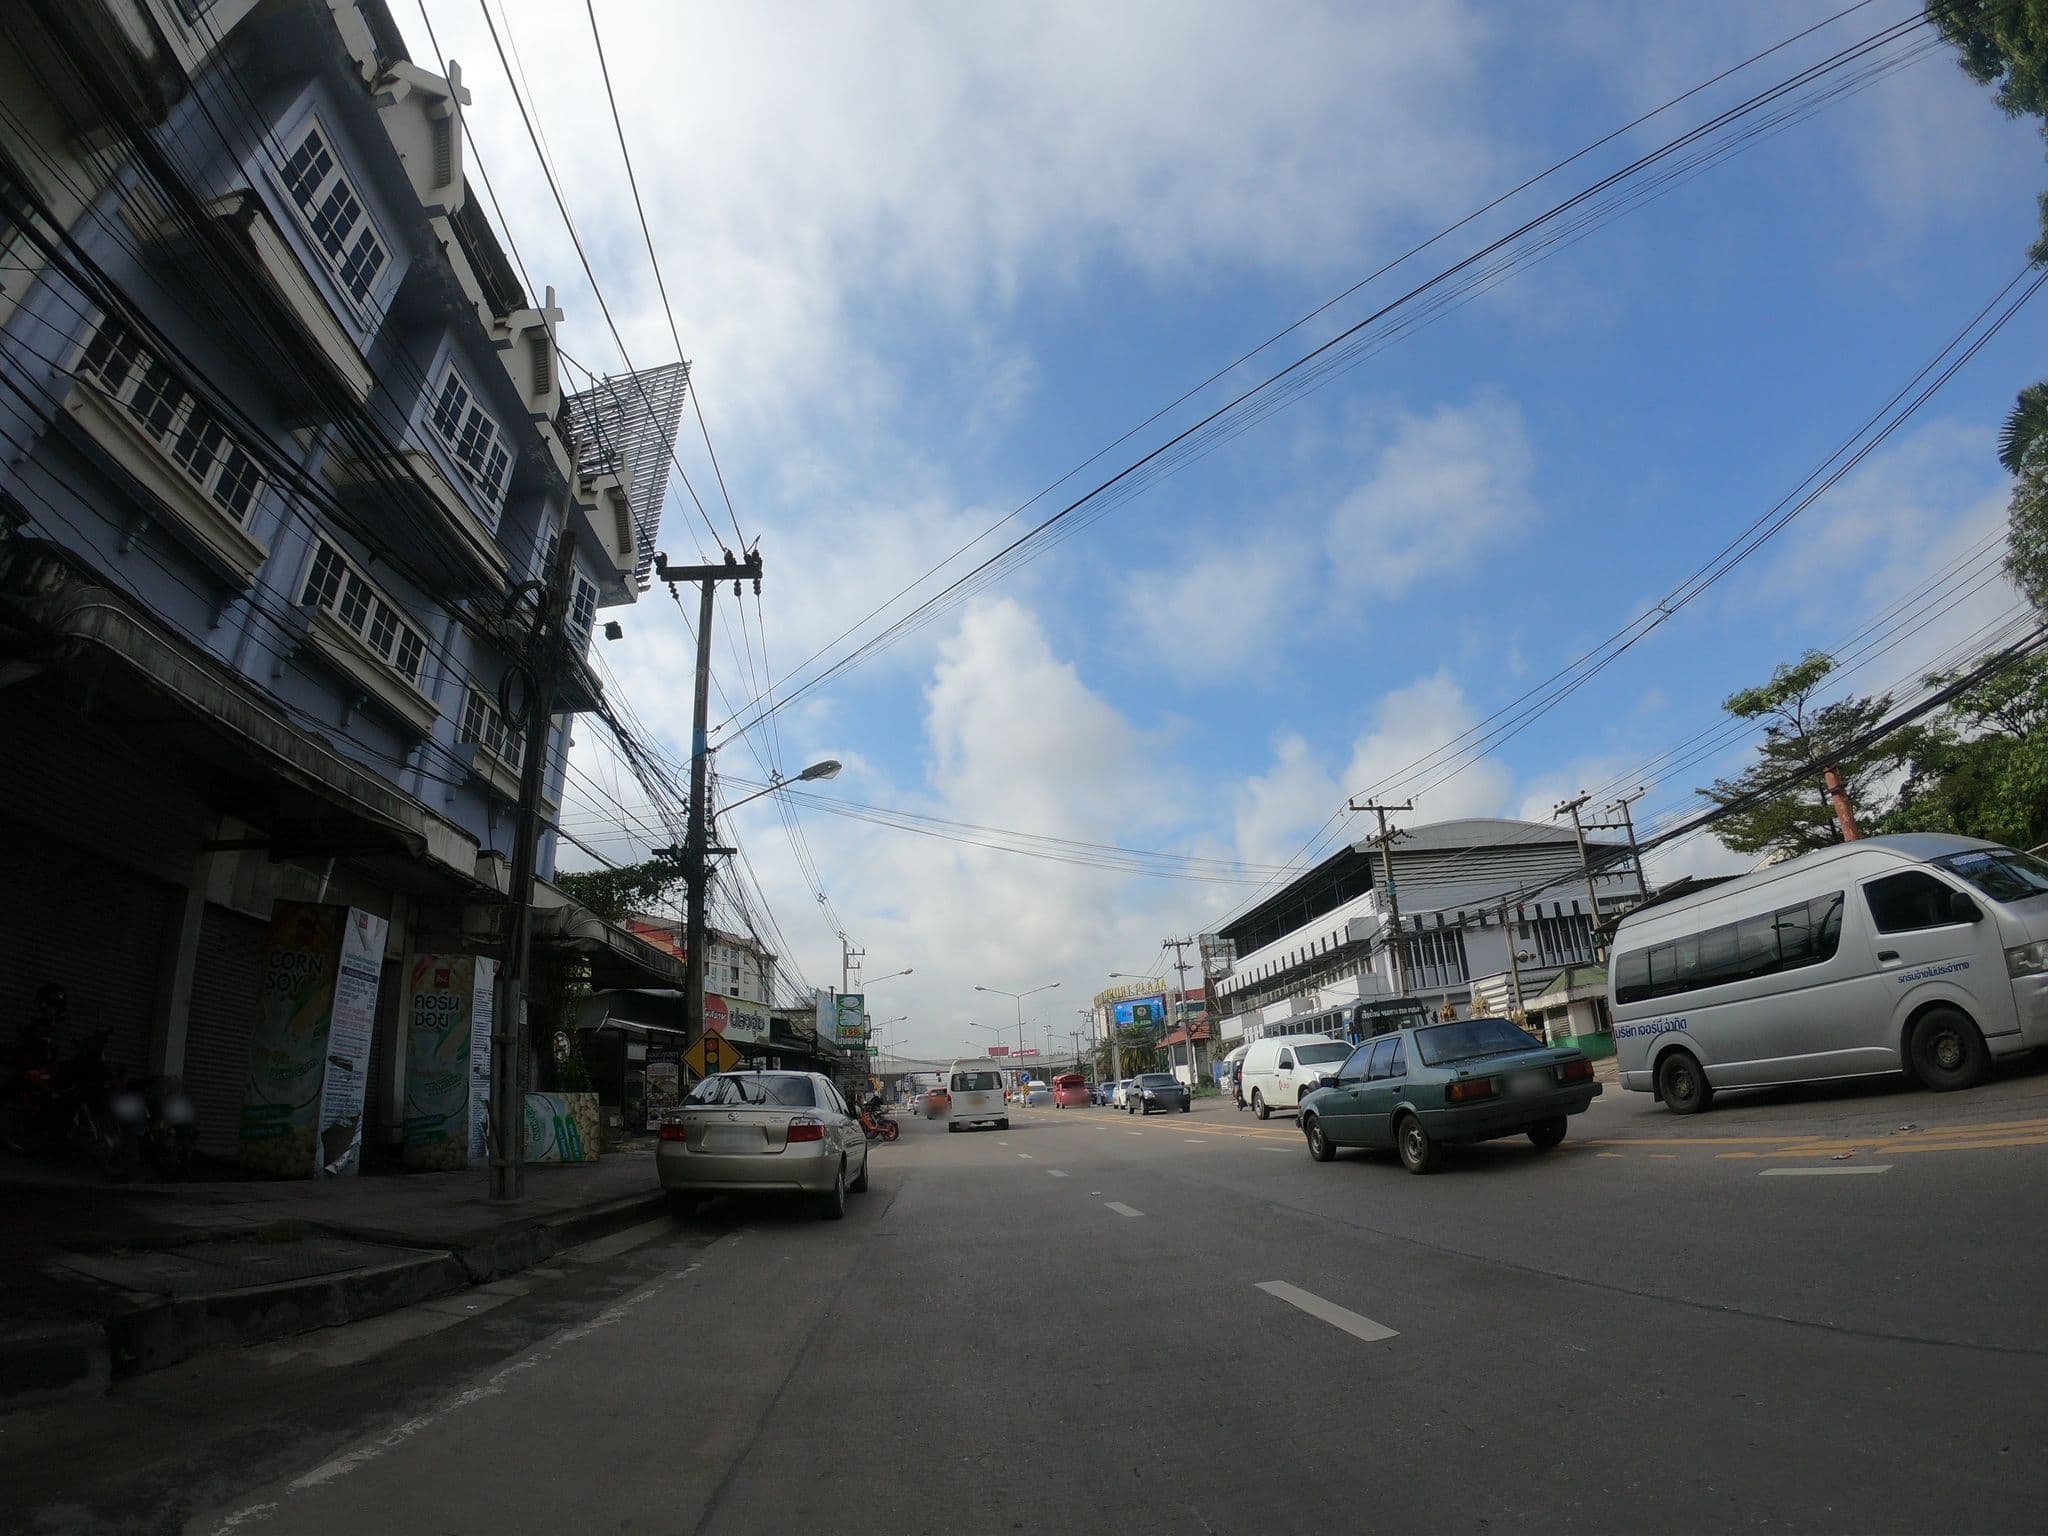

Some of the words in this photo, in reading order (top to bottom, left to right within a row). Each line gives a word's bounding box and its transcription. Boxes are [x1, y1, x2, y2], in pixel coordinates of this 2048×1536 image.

[270, 951, 321, 972] CORN
[268, 972, 304, 992] SOY
[1135, 976, 1167, 997] PLAZA
[1664, 1017, 1687, 1032] จำกัด
